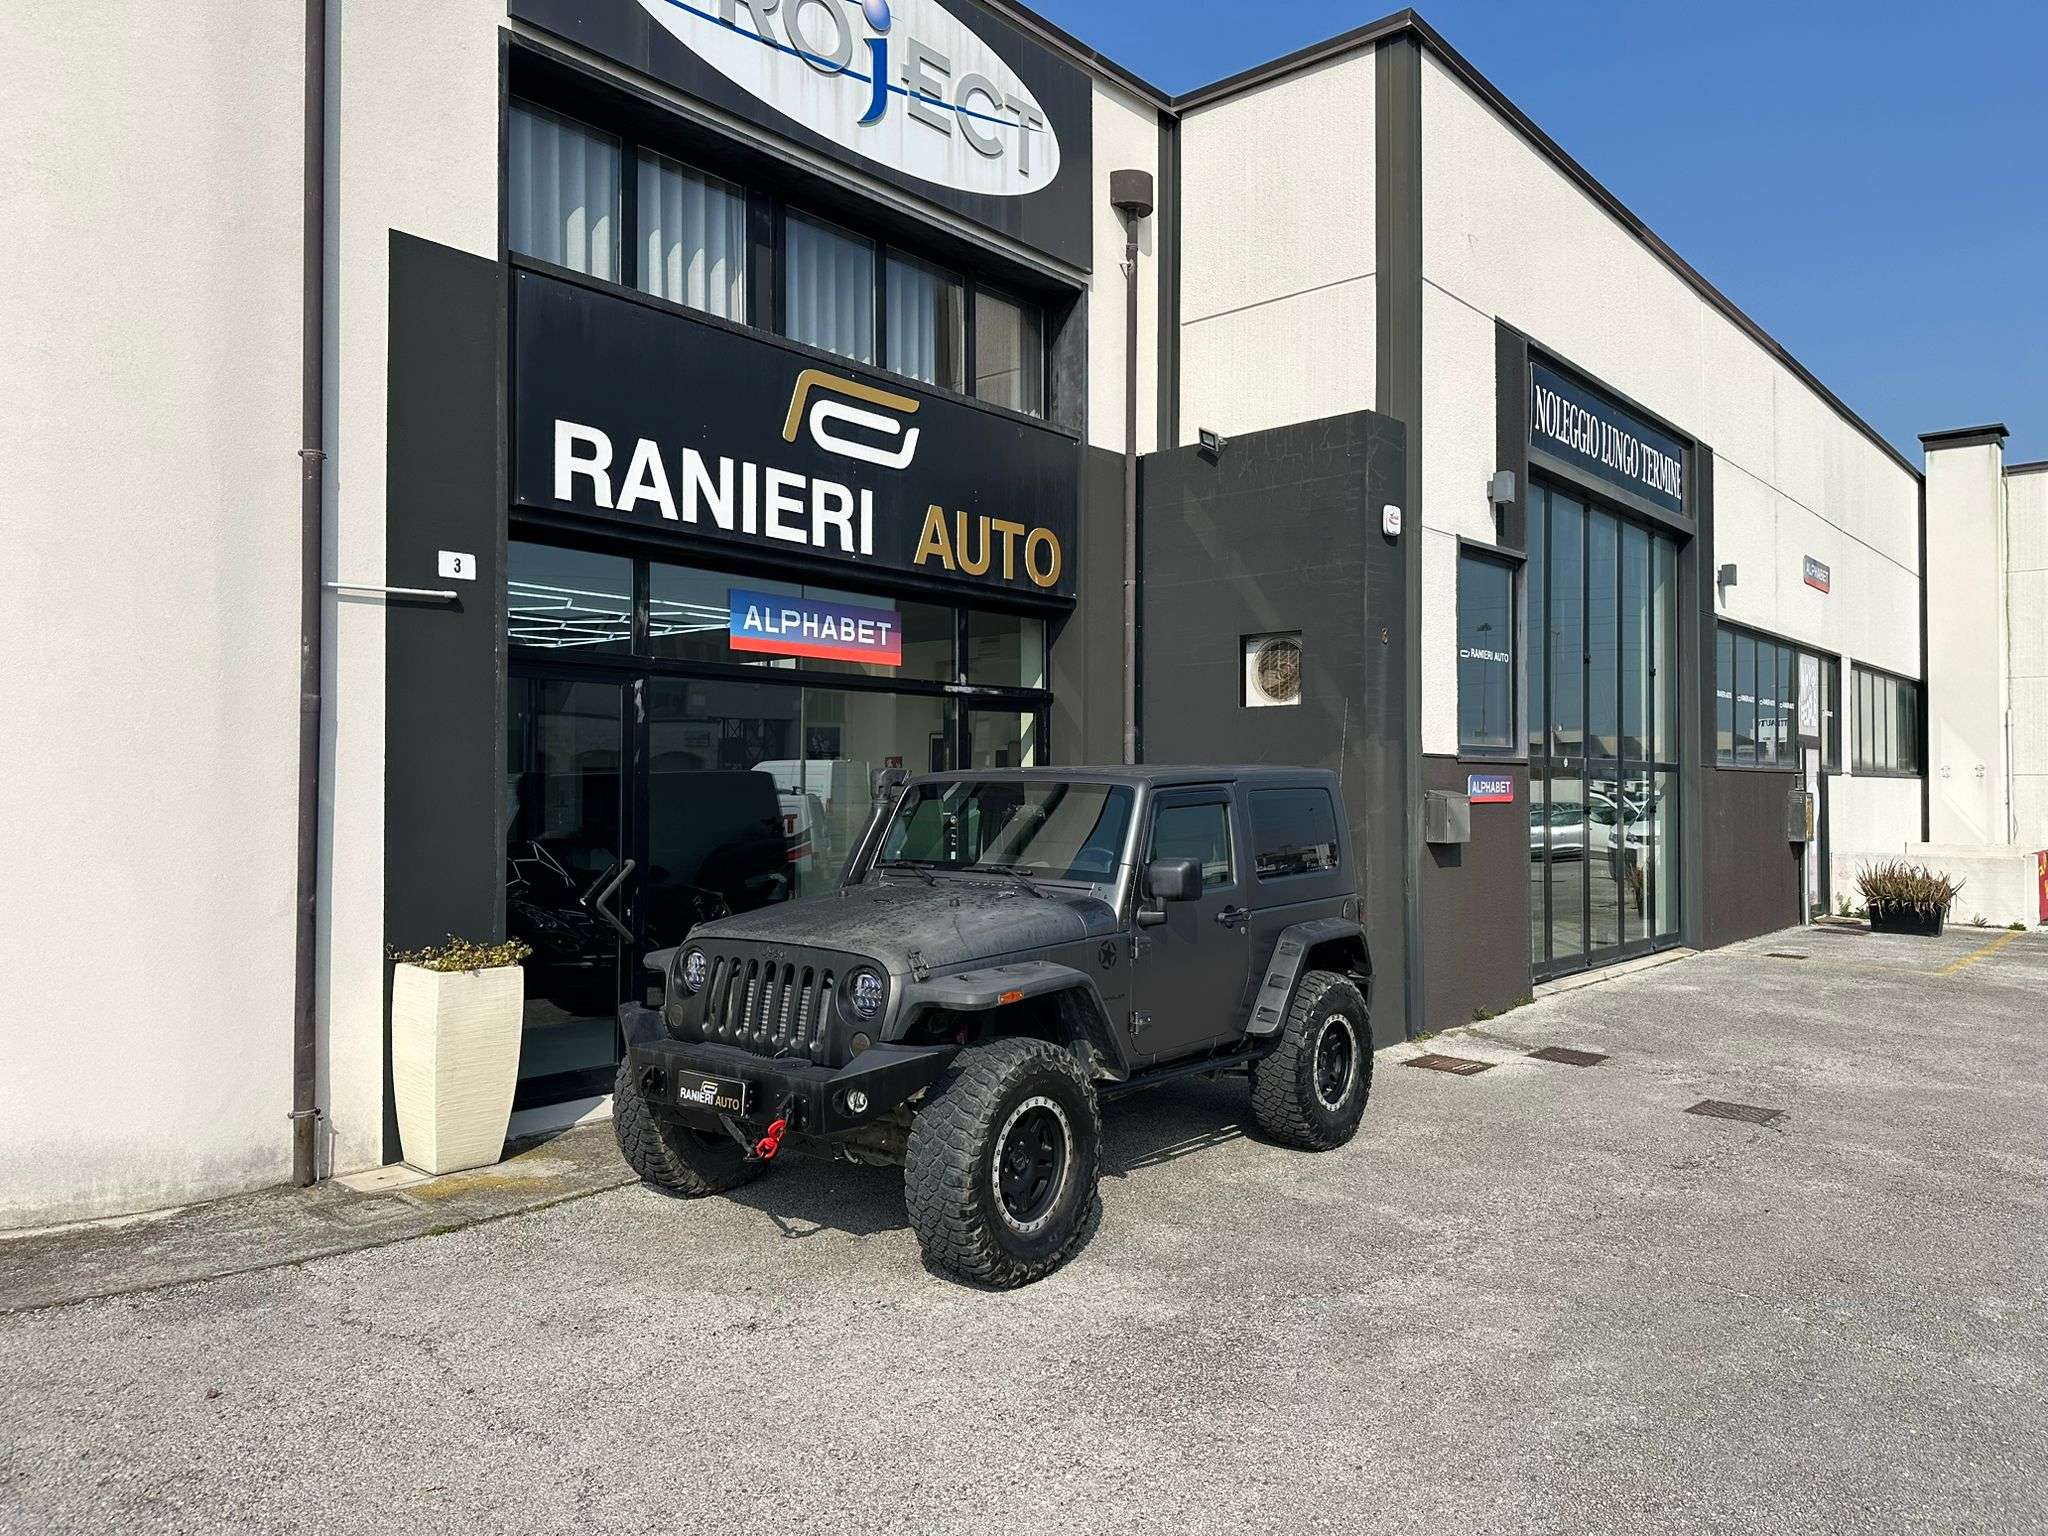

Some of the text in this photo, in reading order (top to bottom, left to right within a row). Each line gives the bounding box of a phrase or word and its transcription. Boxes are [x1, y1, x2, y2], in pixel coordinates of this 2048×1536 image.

[1535, 385, 1682, 500] NOLEGGIO LUNGO TERMINE
[554, 418, 1062, 588] RANIERI AUTO
[454, 557, 461, 573] 3
[743, 605, 892, 646] ALPHABET
[1494, 652, 1509, 663] AUTO
[1472, 781, 1511, 793] ALPHABET
[680, 1087, 740, 1110] RANIERI AUTO
